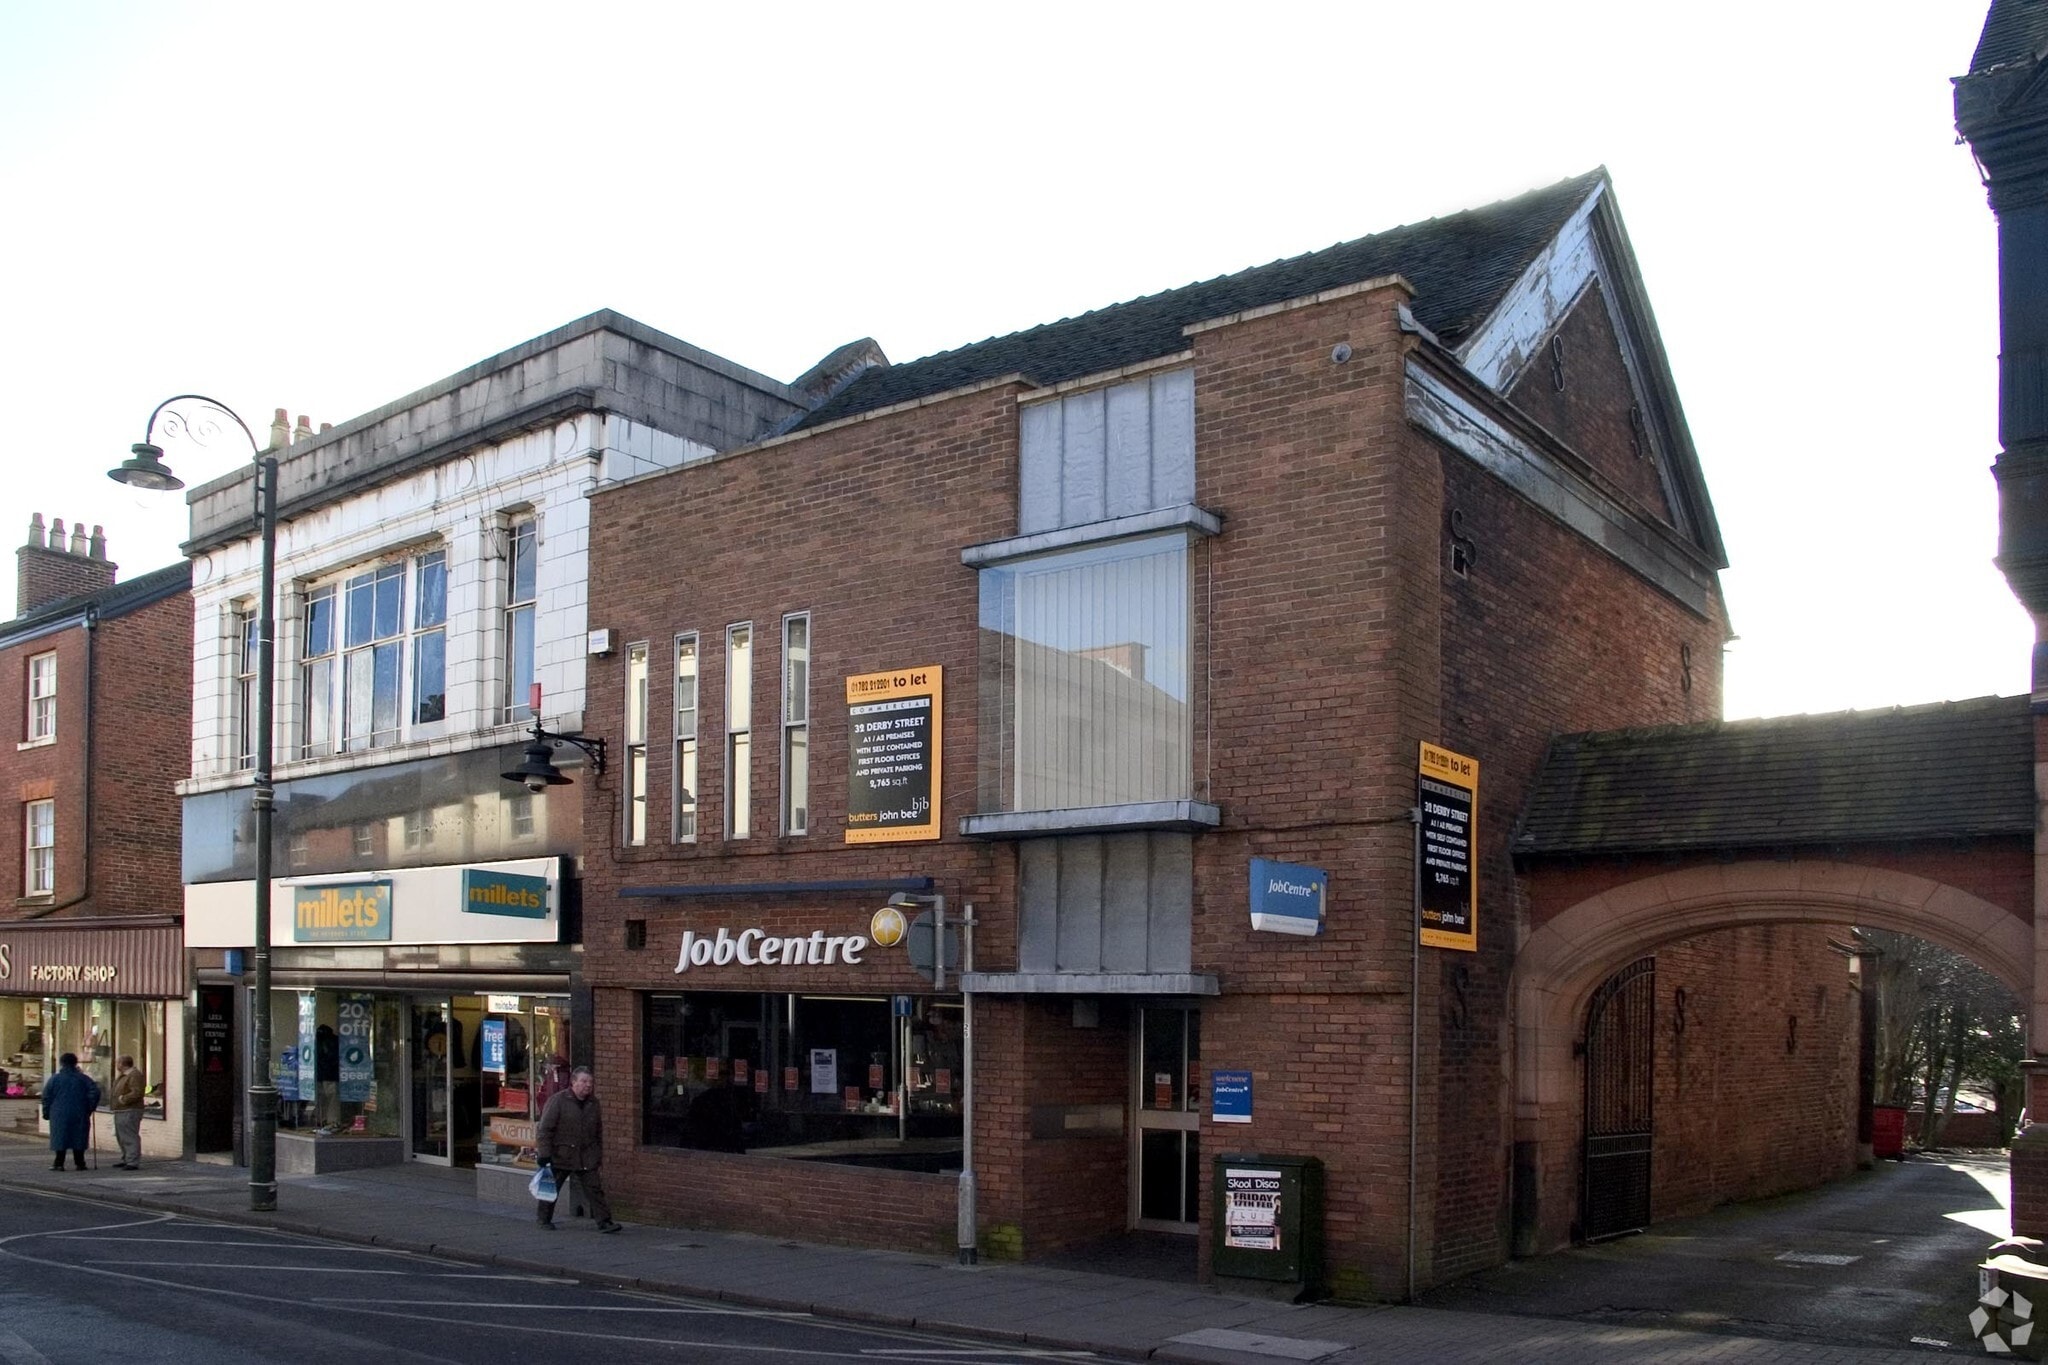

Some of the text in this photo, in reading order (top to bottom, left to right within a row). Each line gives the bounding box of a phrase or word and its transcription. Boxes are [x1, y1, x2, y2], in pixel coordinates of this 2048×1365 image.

[893, 673, 926, 687] to let
[852, 700, 928, 714] COMMERCIAL
[854, 717, 925, 733] 32 DERBY STREET
[886, 731, 915, 740] PREMISES
[872, 745, 885, 753] SELF
[886, 741, 923, 751] CONTAINED
[896, 753, 920, 761] OFFICES
[870, 766, 893, 775] PRIVATE
[895, 764, 923, 773] PARKING
[1451, 757, 1459, 771] to
[1461, 760, 1470, 776] let
[869, 779, 890, 789] 2,765
[912, 796, 929, 814] bjb
[848, 809, 918, 822] butters john bee
[1433, 804, 1450, 817] DERBY
[1451, 809, 1468, 822] STREET
[1268, 879, 1311, 897] JobCentre
[469, 884, 541, 908] millets
[297, 888, 379, 928] millets
[1422, 907, 1464, 925] butters john bee
[674, 927, 869, 974] JobCentre
[31, 965, 116, 982] FACTORY SHOP
[340, 1020, 369, 1036] off
[484, 1029, 503, 1042] free
[340, 1071, 370, 1082] gear
[1227, 1178, 1280, 1189] Skool Disco
[1233, 1192, 1273, 1202] FRIDAY
[1256, 1201, 1273, 1209] FEB
